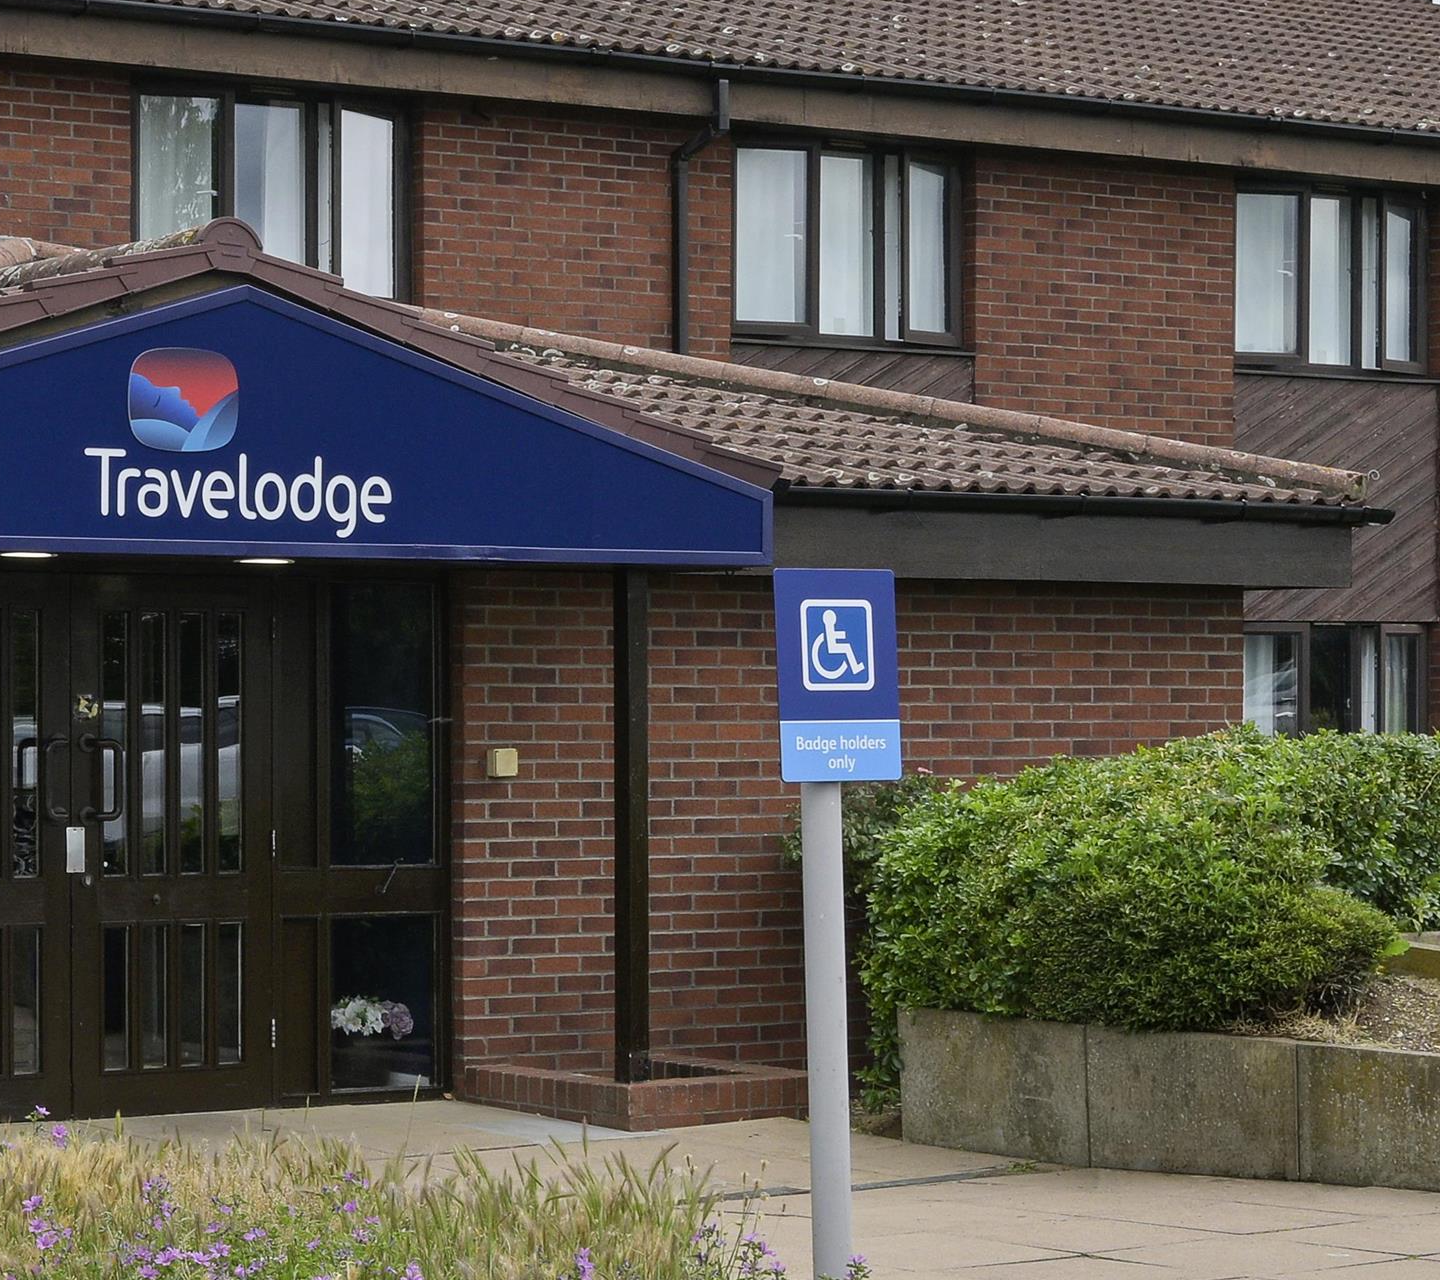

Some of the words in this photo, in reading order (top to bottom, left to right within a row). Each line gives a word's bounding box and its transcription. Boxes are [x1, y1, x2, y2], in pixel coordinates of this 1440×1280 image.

[84, 447, 392, 539] Travelodge
[796, 736, 837, 754] Badge
[840, 735, 886, 750] holders
[828, 754, 856, 772] only
